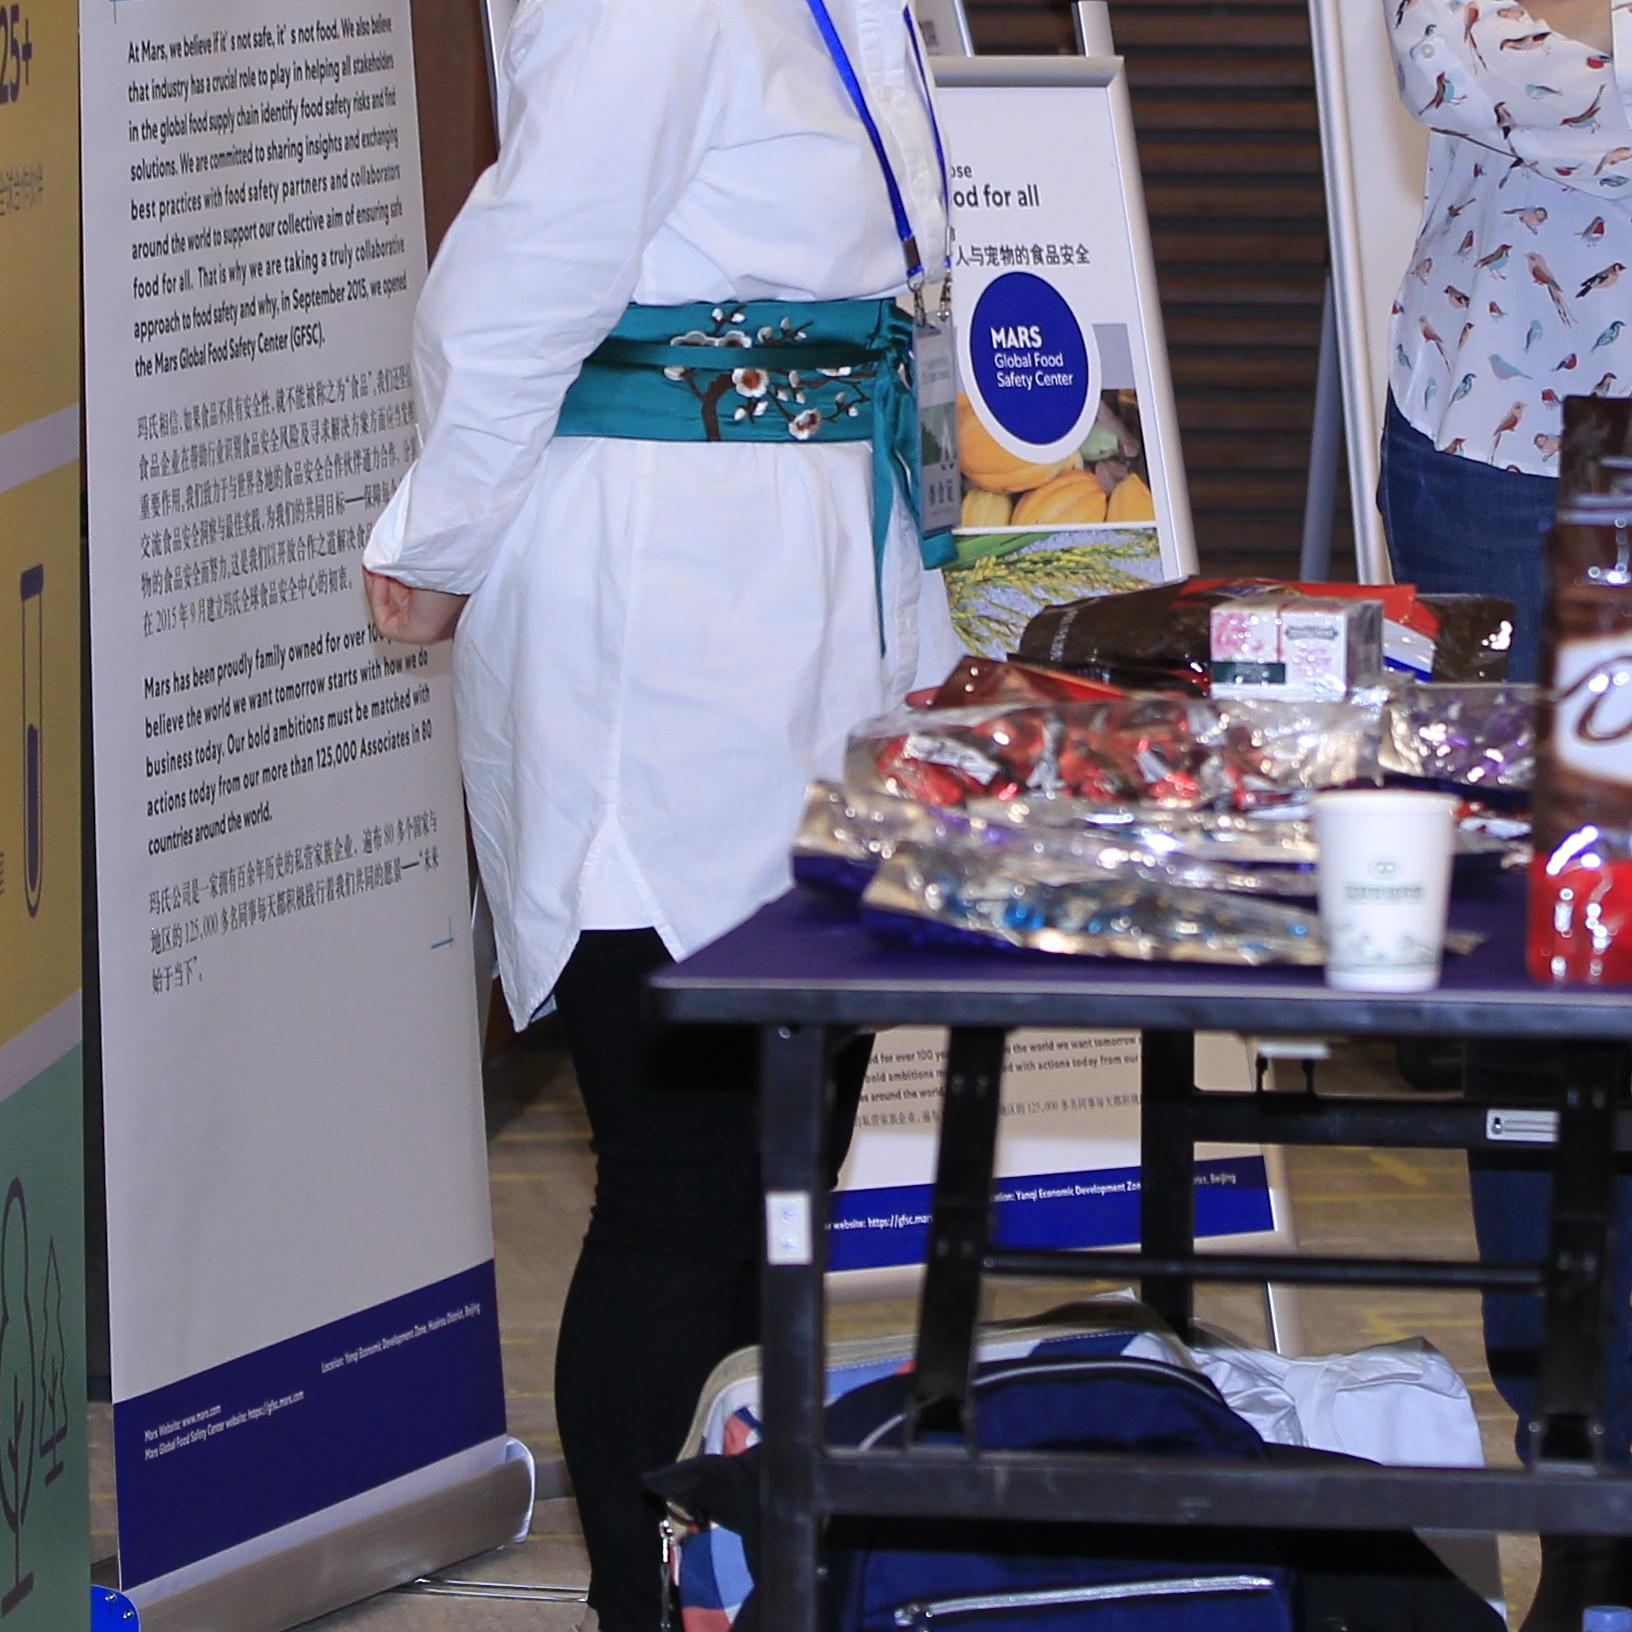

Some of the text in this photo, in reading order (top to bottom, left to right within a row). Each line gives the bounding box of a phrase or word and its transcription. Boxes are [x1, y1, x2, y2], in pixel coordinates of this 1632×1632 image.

[130, 164, 400, 223] best practices with food safety partners and collaborators
[984, 185, 1012, 208] for
[1018, 184, 1040, 207] all
[132, 237, 405, 299] food for all. That is why we are taking a truly collaborative
[133, 270, 407, 344] approach to food safety and why, in September 2015, we opened
[134, 321, 325, 378] the Mars Global Food Safety Center (GFSC).
[991, 325, 1043, 349] MARS
[994, 352, 1063, 368] Global Food
[997, 371, 1073, 391] Safety Center
[143, 676, 171, 700] Mars
[172, 670, 191, 693] has
[192, 666, 215, 688] been
[216, 651, 253, 686] proudly
[254, 643, 286, 671] family
[287, 634, 323, 662] owned
[324, 632, 341, 654] for
[342, 629, 366, 650] over
[144, 647, 428, 739] believe the world we want tomorrow starts with how we do
[145, 682, 430, 778] business today. Our bold ambitions must be matched with
[146, 717, 432, 817] actions today from our more than 125,000 Associates in 80
[147, 800, 272, 856] countries around the world.
[1029, 1040, 1055, 1053] world
[1070, 1038, 1092, 1050] want
[1094, 1036, 1136, 1048] tomorrow
[1072, 1056, 1098, 1070] today
[1100, 1054, 1122, 1067] from
